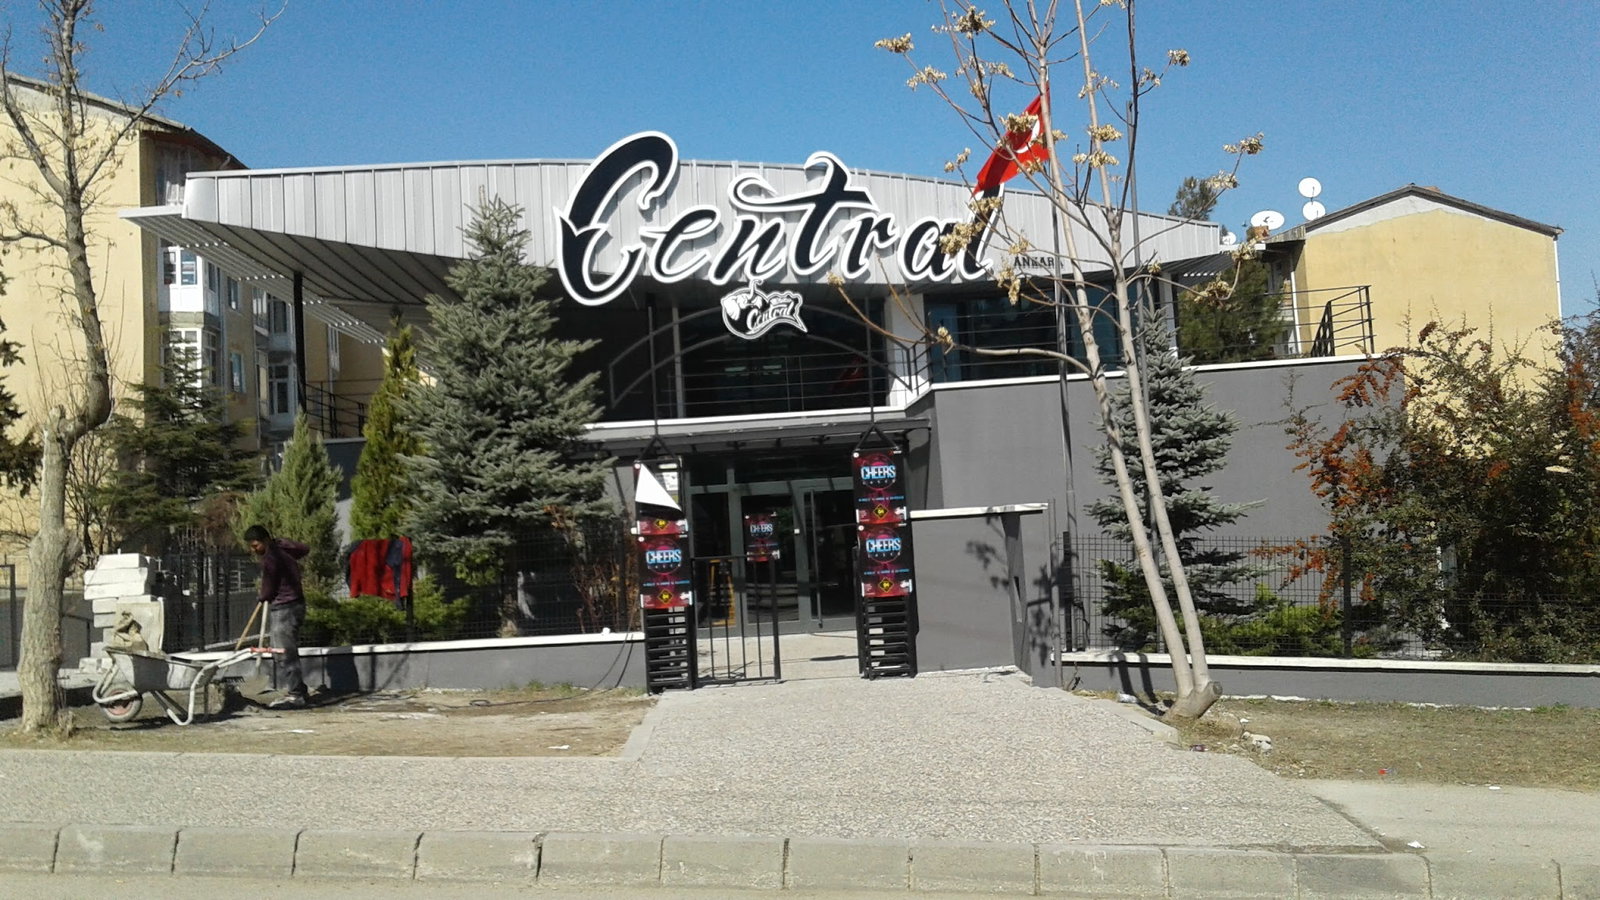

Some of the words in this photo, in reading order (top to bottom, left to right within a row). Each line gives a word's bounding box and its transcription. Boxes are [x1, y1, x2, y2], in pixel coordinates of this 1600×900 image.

[553, 130, 1004, 306] Central
[746, 300, 794, 334] Central
[860, 465, 896, 480] CHEERS
[865, 537, 901, 552] CHEERS
[645, 549, 682, 564] CHEERS
